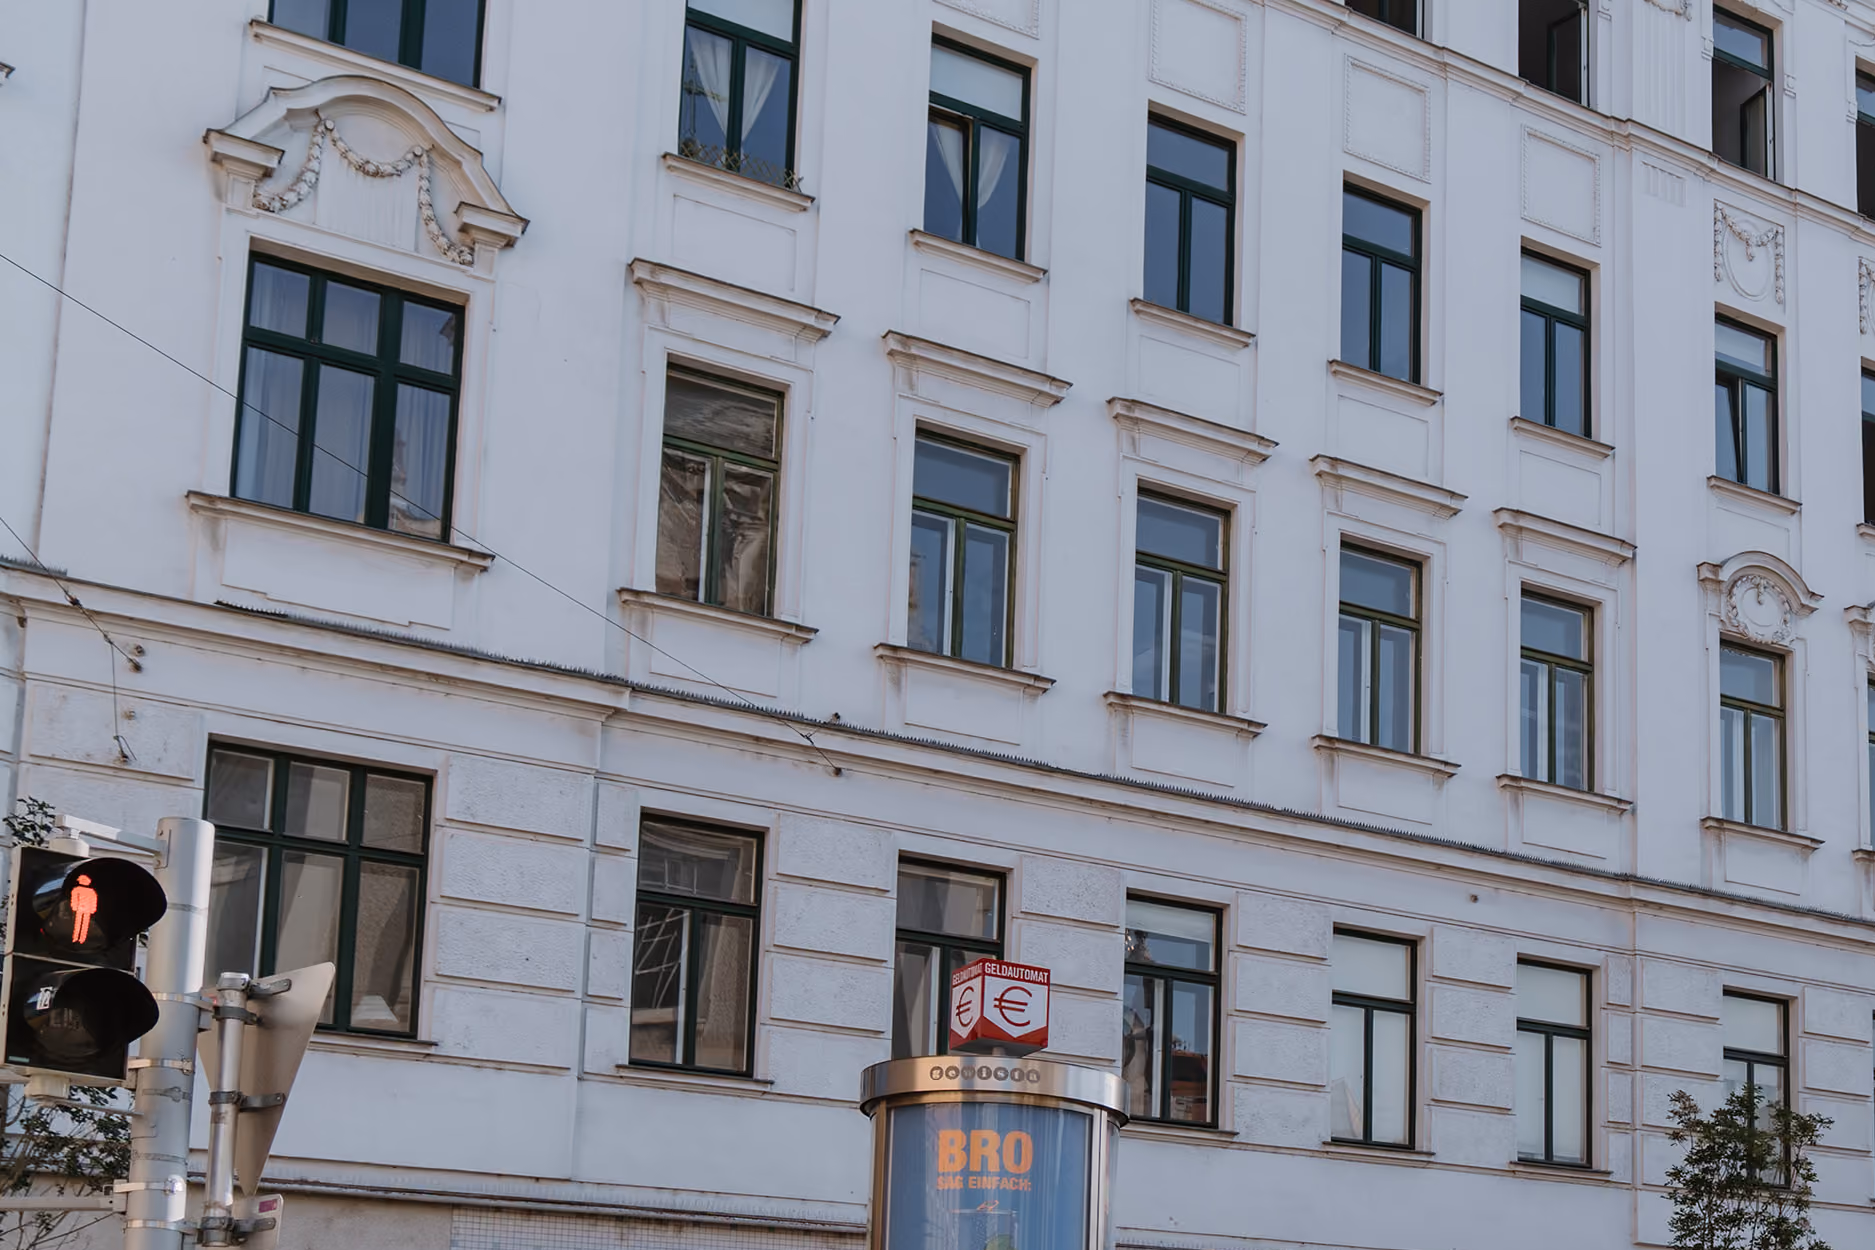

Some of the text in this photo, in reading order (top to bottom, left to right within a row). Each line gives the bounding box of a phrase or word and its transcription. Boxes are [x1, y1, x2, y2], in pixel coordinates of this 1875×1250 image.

[984, 962, 1049, 984] GELDAUTOMAT
[938, 1129, 1033, 1174] BRO
[936, 1176, 1032, 1191] SAG EINFACH:
